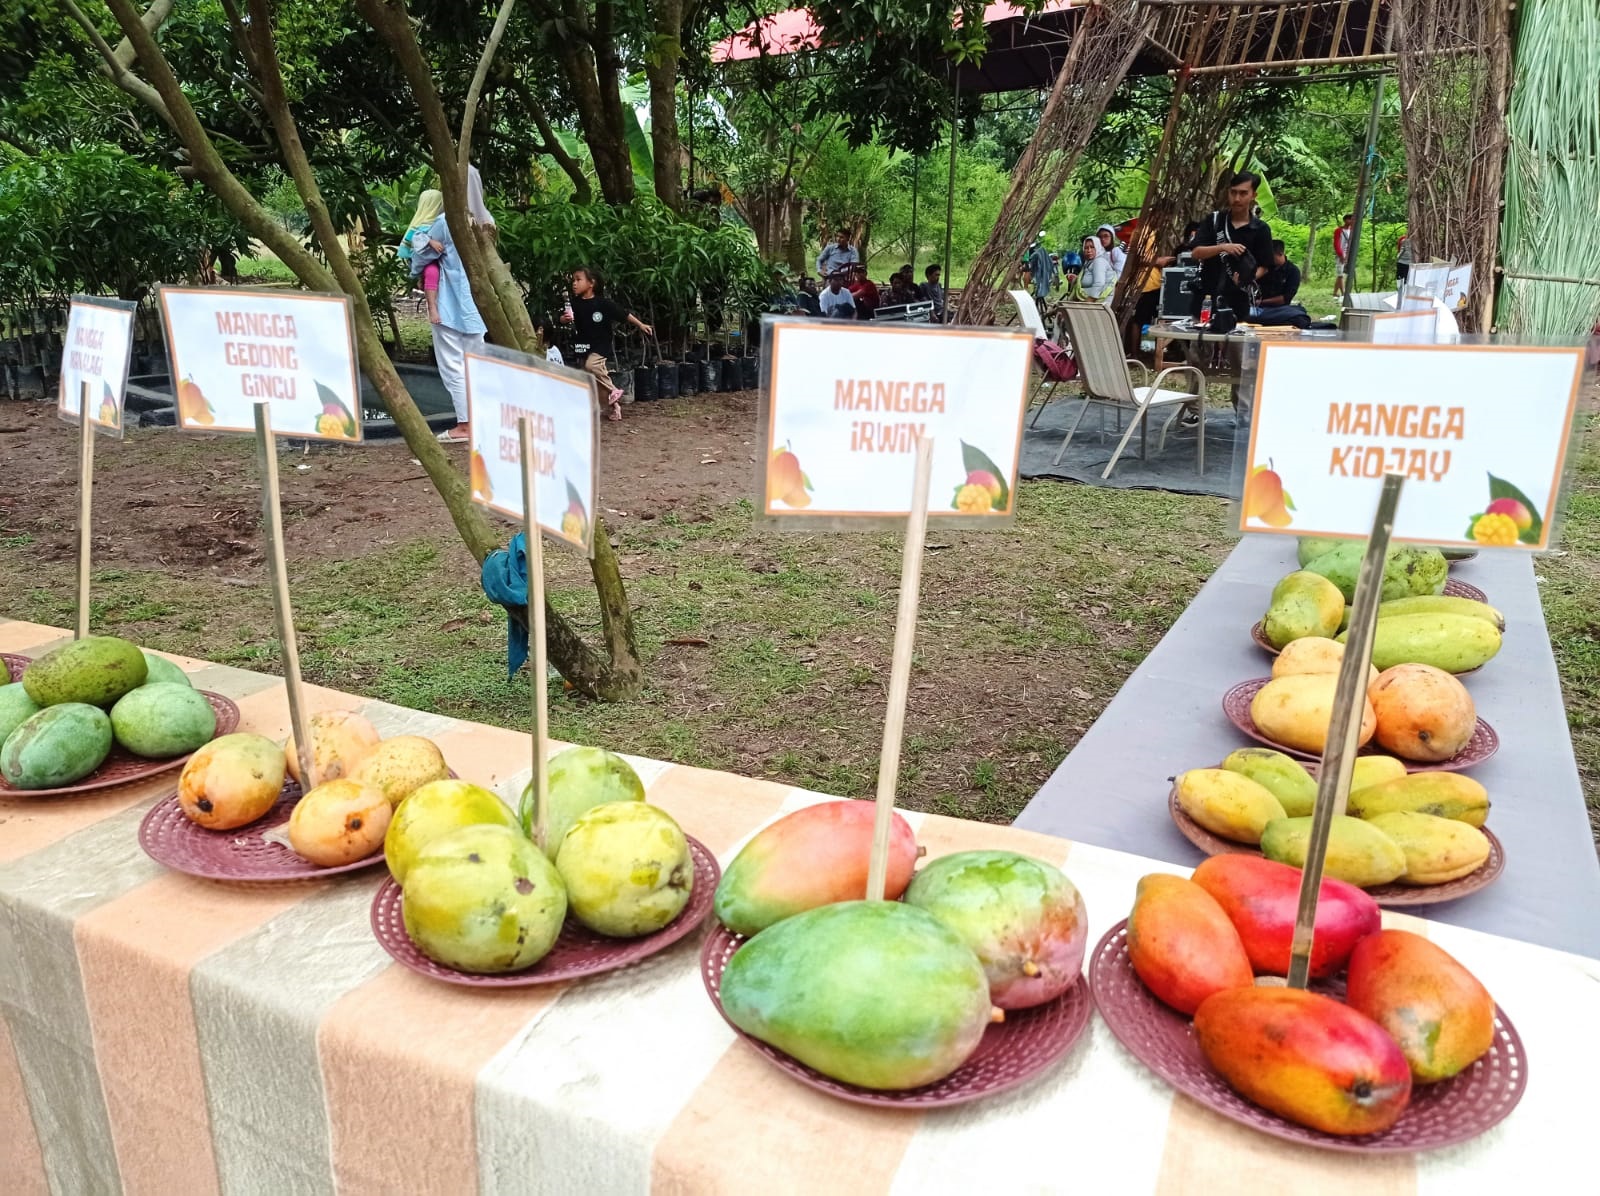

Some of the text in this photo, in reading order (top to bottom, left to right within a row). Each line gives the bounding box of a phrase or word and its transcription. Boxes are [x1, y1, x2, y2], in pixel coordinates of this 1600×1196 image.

[215, 311, 298, 340] MANGGA
[224, 342, 298, 370] GEDONG
[834, 379, 946, 414] MANGGA
[1327, 402, 1465, 440] MANGGA
